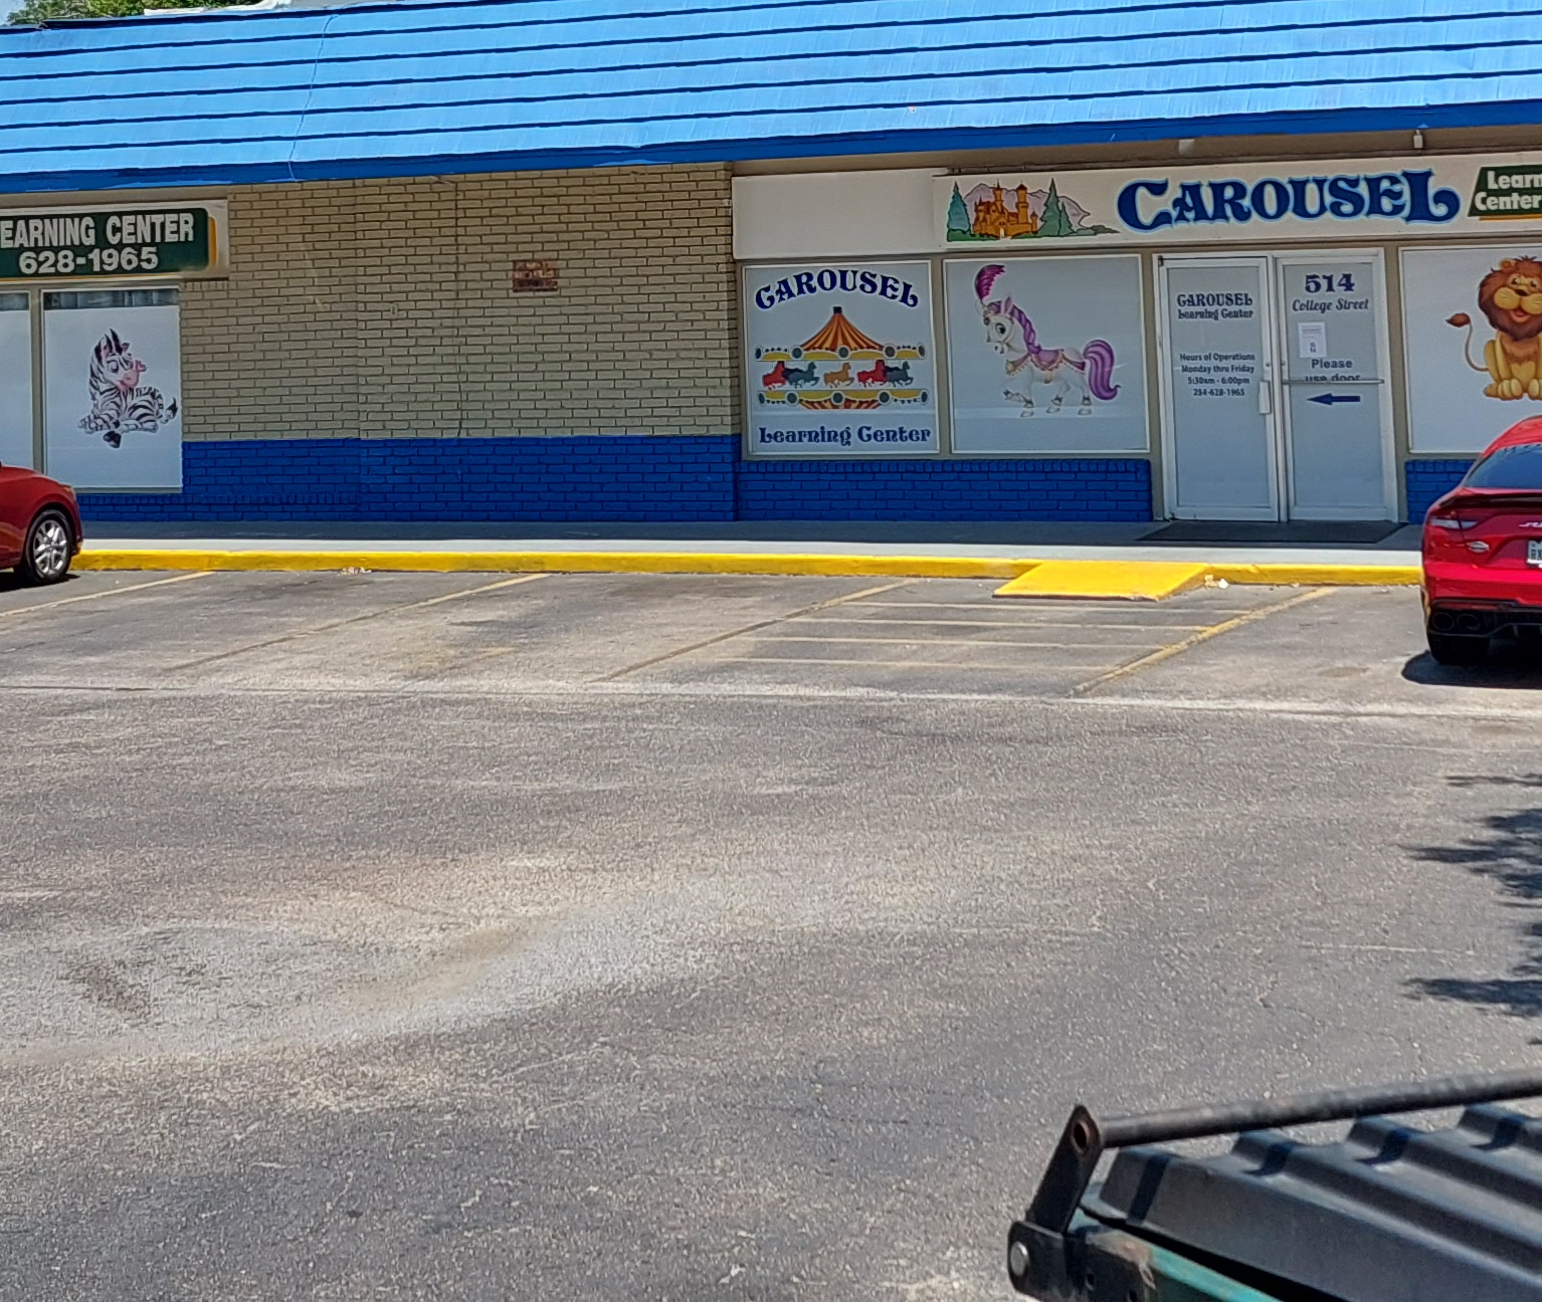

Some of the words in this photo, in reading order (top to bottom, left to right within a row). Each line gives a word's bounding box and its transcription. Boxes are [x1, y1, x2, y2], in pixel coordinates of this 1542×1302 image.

[1117, 169, 1460, 231] CAROUSEL
[1474, 191, 1542, 211] Center
[106, 212, 195, 245] CENTER
[18, 246, 159, 275] 628-1965
[755, 268, 919, 310] CAROUSEL
[1304, 273, 1356, 293] 514
[1177, 293, 1254, 307] CAROUSEL
[1292, 299, 1333, 314] College
[1336, 298, 1369, 310] Street
[1178, 308, 1219, 321] Learning
[1221, 308, 1254, 319] Center
[1179, 353, 1203, 362] Hours
[1203, 352, 1211, 361] of
[1213, 353, 1255, 363] Operations
[1311, 359, 1353, 369] Please
[1181, 364, 1211, 374] Monday
[1213, 364, 1229, 373] thru
[1231, 364, 1255, 374] Friday
[758, 426, 852, 447] Learning
[857, 425, 931, 443] Center
